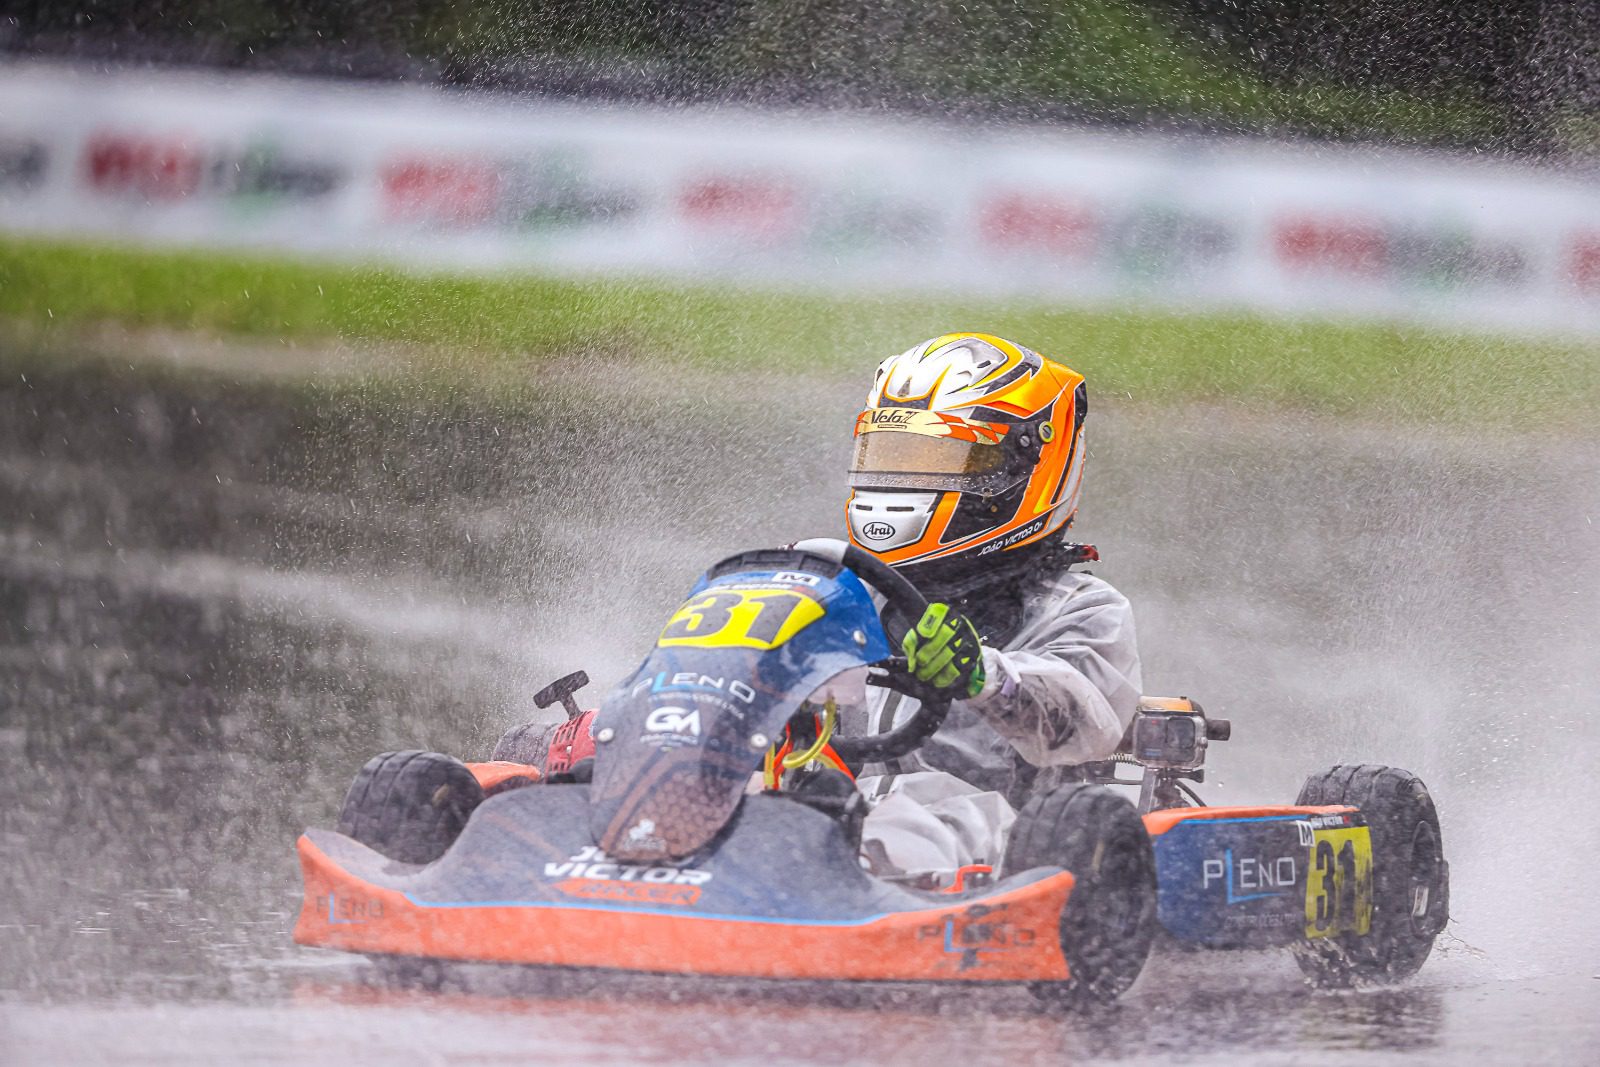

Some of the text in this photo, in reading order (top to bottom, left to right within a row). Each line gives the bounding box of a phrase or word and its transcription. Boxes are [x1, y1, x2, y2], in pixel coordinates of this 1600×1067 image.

[865, 523, 891, 535] Arai
[1005, 525, 1033, 546] VICTOR
[660, 592, 802, 645] 31
[631, 671, 756, 704] PLENO
[544, 862, 713, 886] VICTOR
[1203, 848, 1296, 905] PLENO
[1315, 839, 1356, 932] 31
